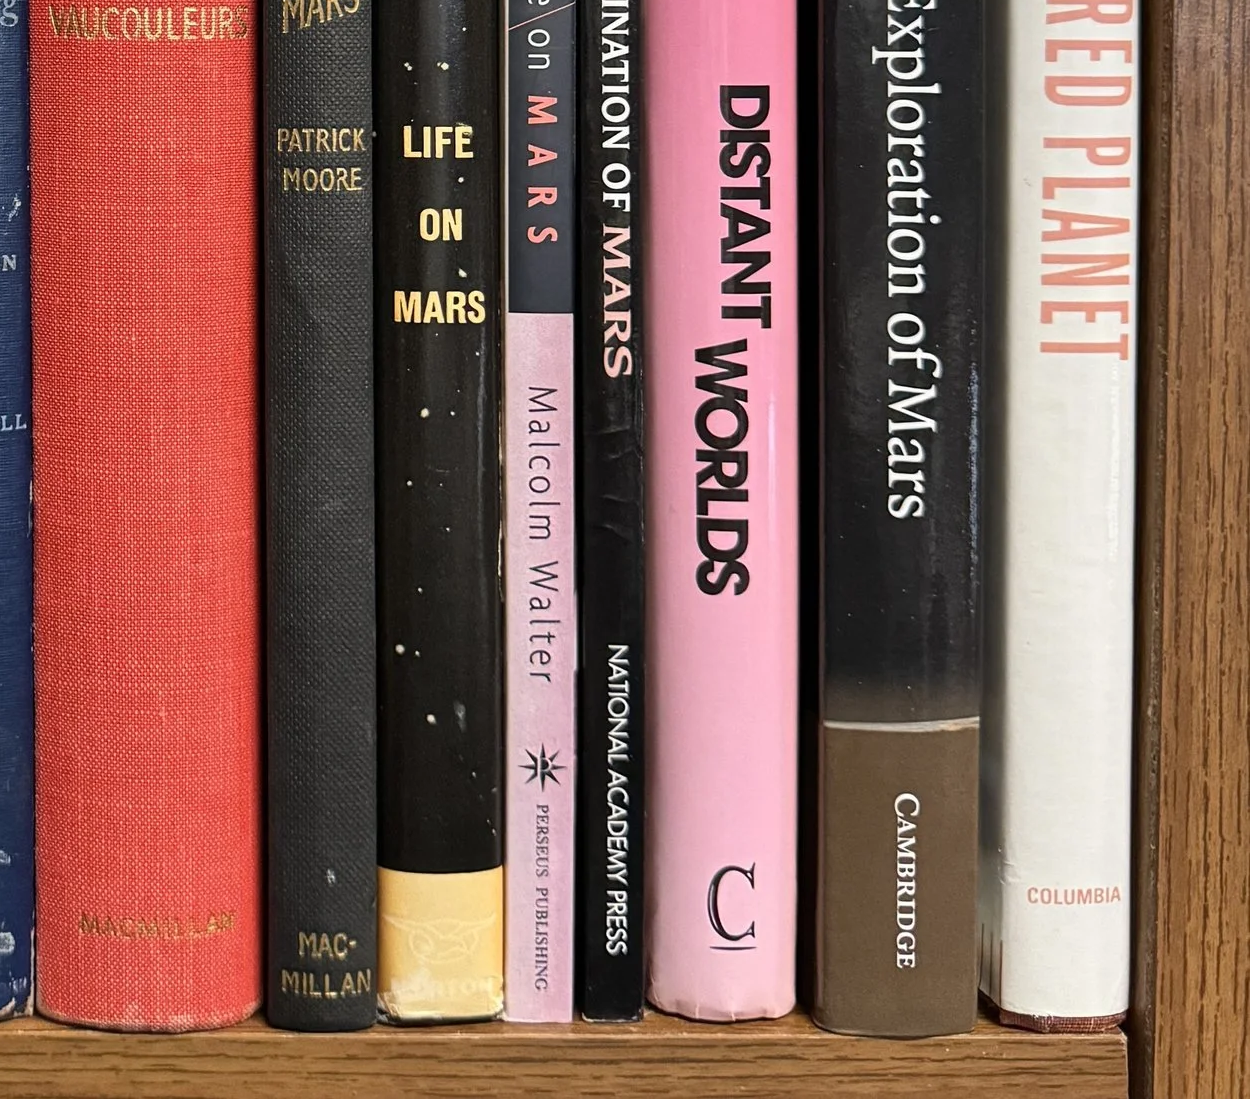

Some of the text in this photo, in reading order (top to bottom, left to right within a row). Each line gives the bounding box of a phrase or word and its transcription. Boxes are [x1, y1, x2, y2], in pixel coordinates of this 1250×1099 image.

[49, 5, 248, 41] VAUCOULEURS
[527, 27, 551, 71] on
[278, 127, 367, 154] PATRICK
[403, 125, 476, 159] LIFE
[282, 164, 363, 193] MOORE
[526, 94, 557, 242] MARS
[602, 162, 632, 212] OF
[419, 209, 464, 242] ON
[1040, 134, 1131, 361] PLANET
[392, 291, 487, 324] MARS
[602, 223, 631, 377] MARS
[694, 84, 771, 597] DISTANT WORLDS
[887, 311, 943, 376] of
[887, 381, 940, 520] Mars
[528, 385, 559, 684] Malcolm Walter
[604, 643, 630, 955] NATIONAL ACADEMY PRESS
[534, 803, 550, 990] PERSEUS PUBLISHING
[892, 792, 920, 971] CAMBRIDGE
[1027, 886, 1121, 905] COLUMBIA
[298, 931, 357, 960] MAC-
[281, 968, 372, 999] MILLAN
